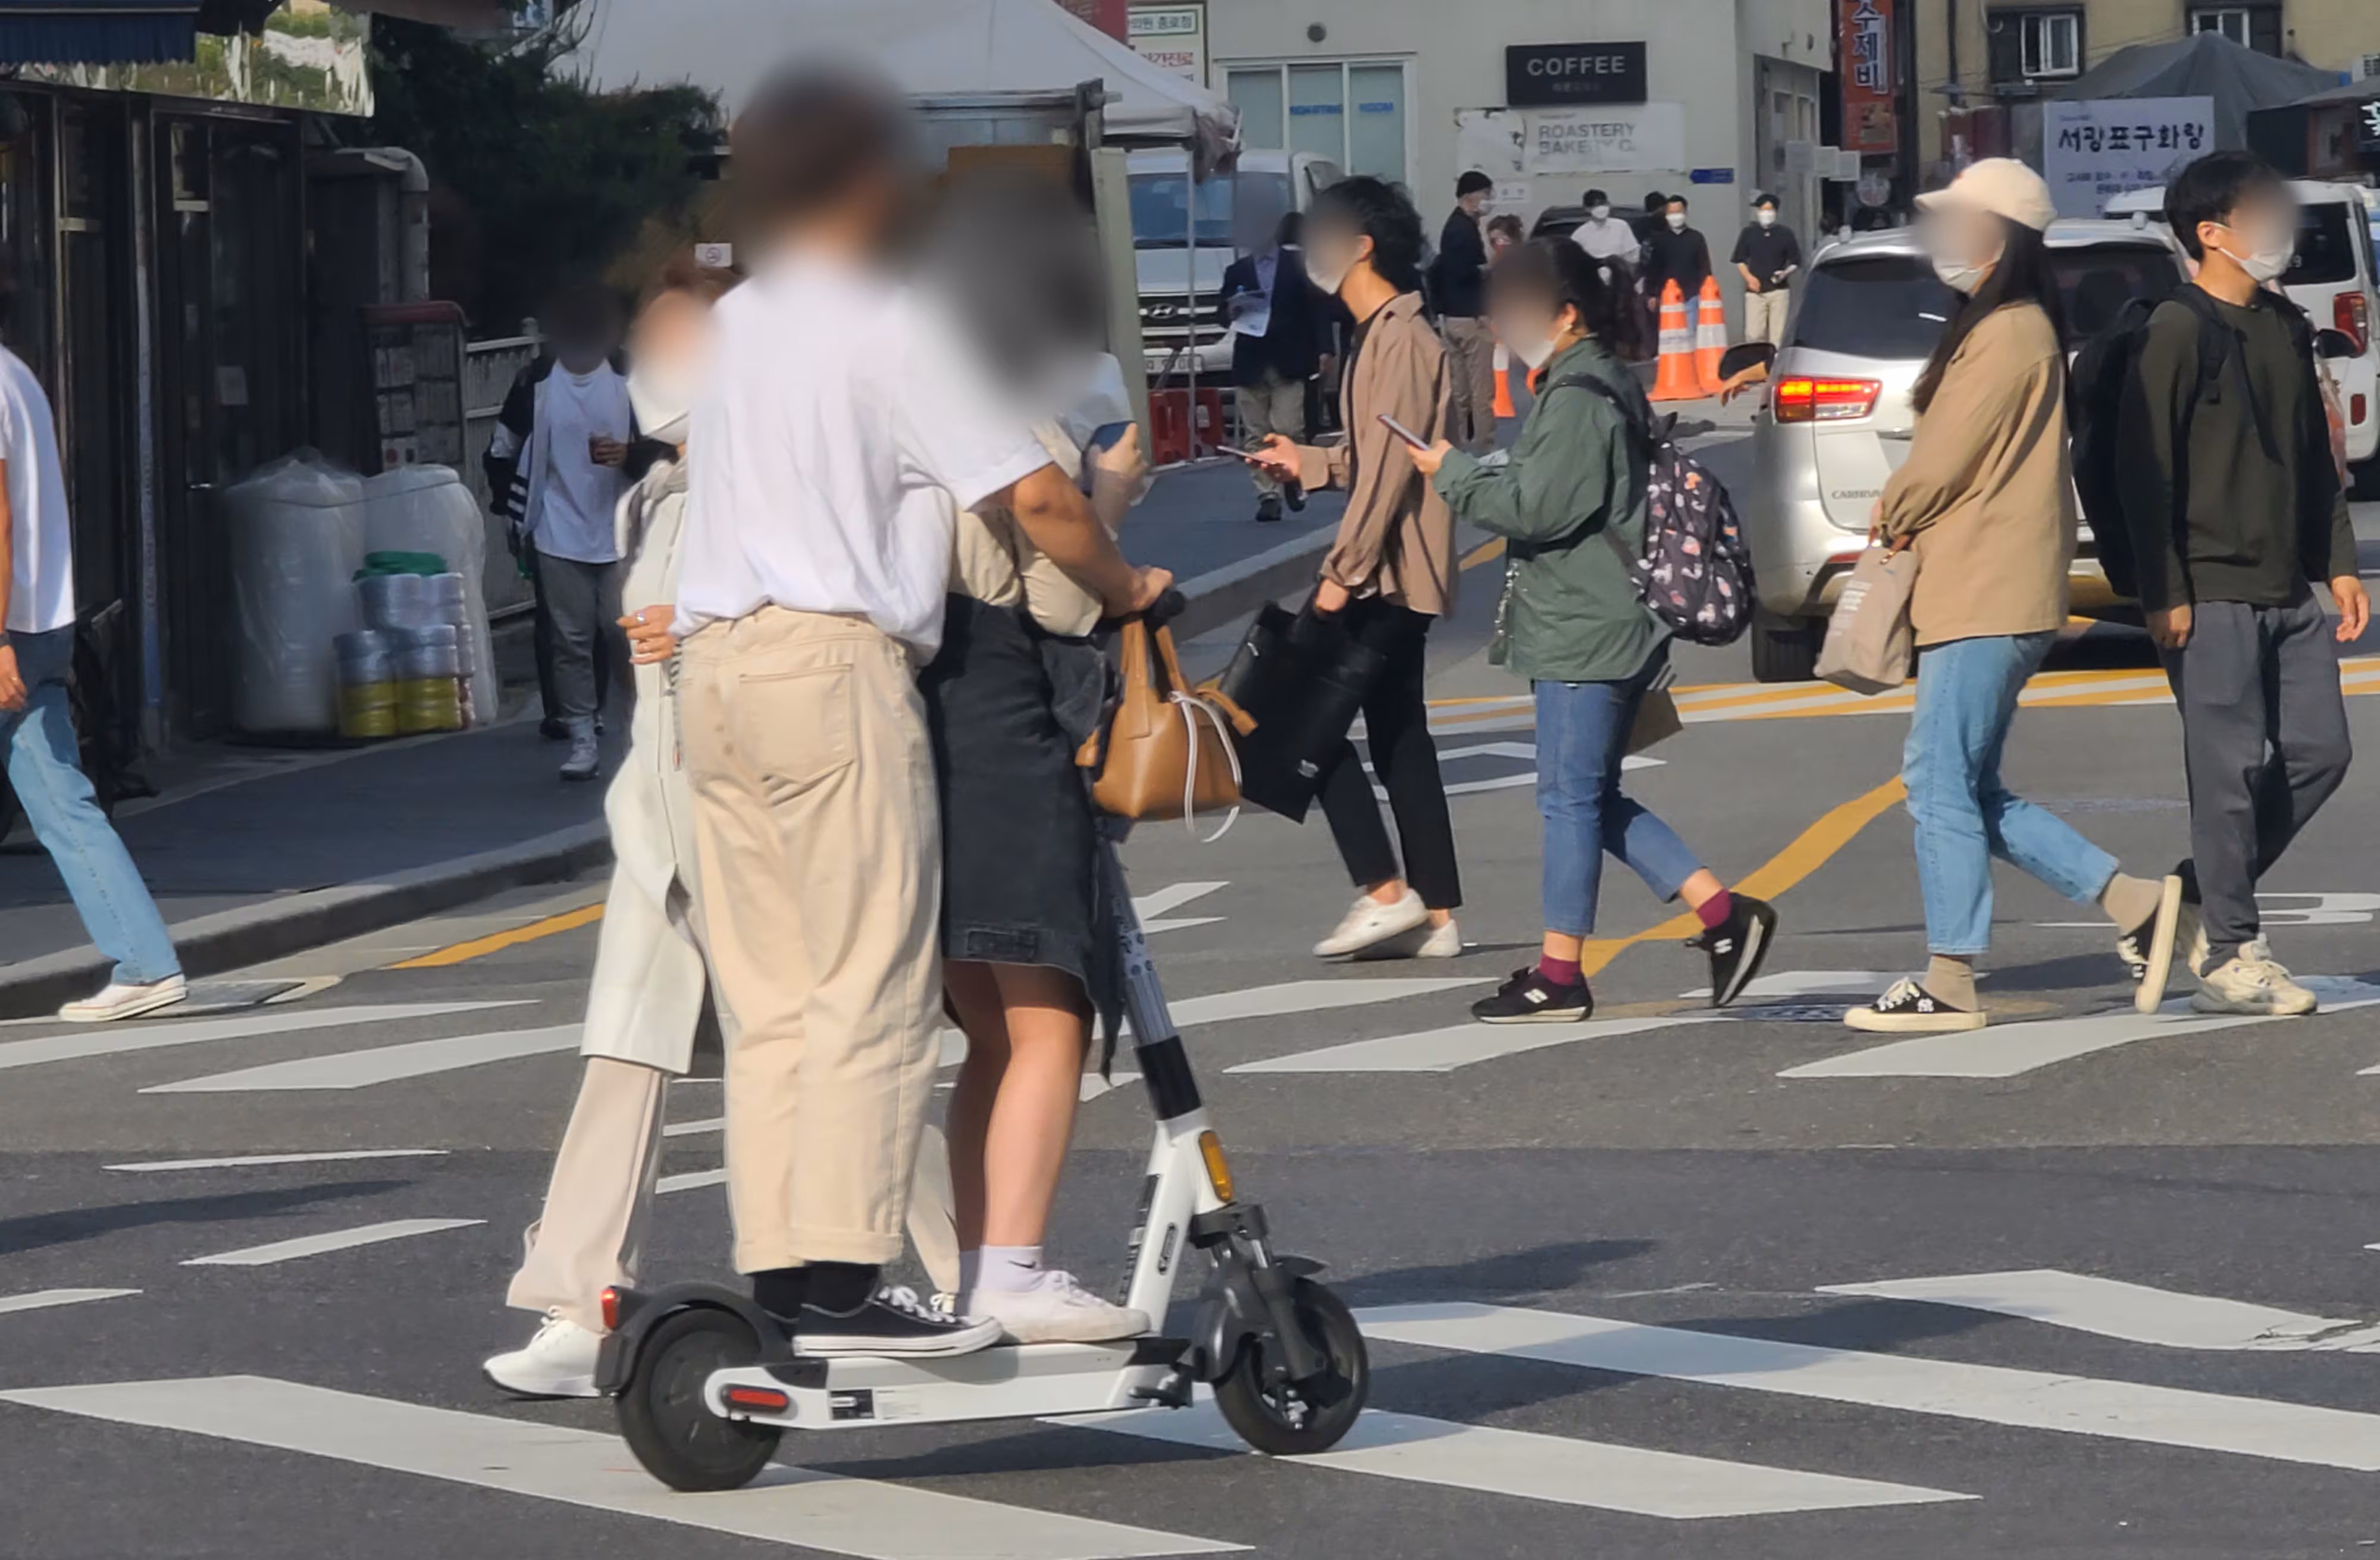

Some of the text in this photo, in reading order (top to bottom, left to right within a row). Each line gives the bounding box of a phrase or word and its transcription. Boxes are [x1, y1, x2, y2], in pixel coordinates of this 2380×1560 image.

[1852, 2, 1880, 91] 수제비
[1527, 55, 1626, 76] COFFEE
[1538, 123, 1637, 139] ROASTERY
